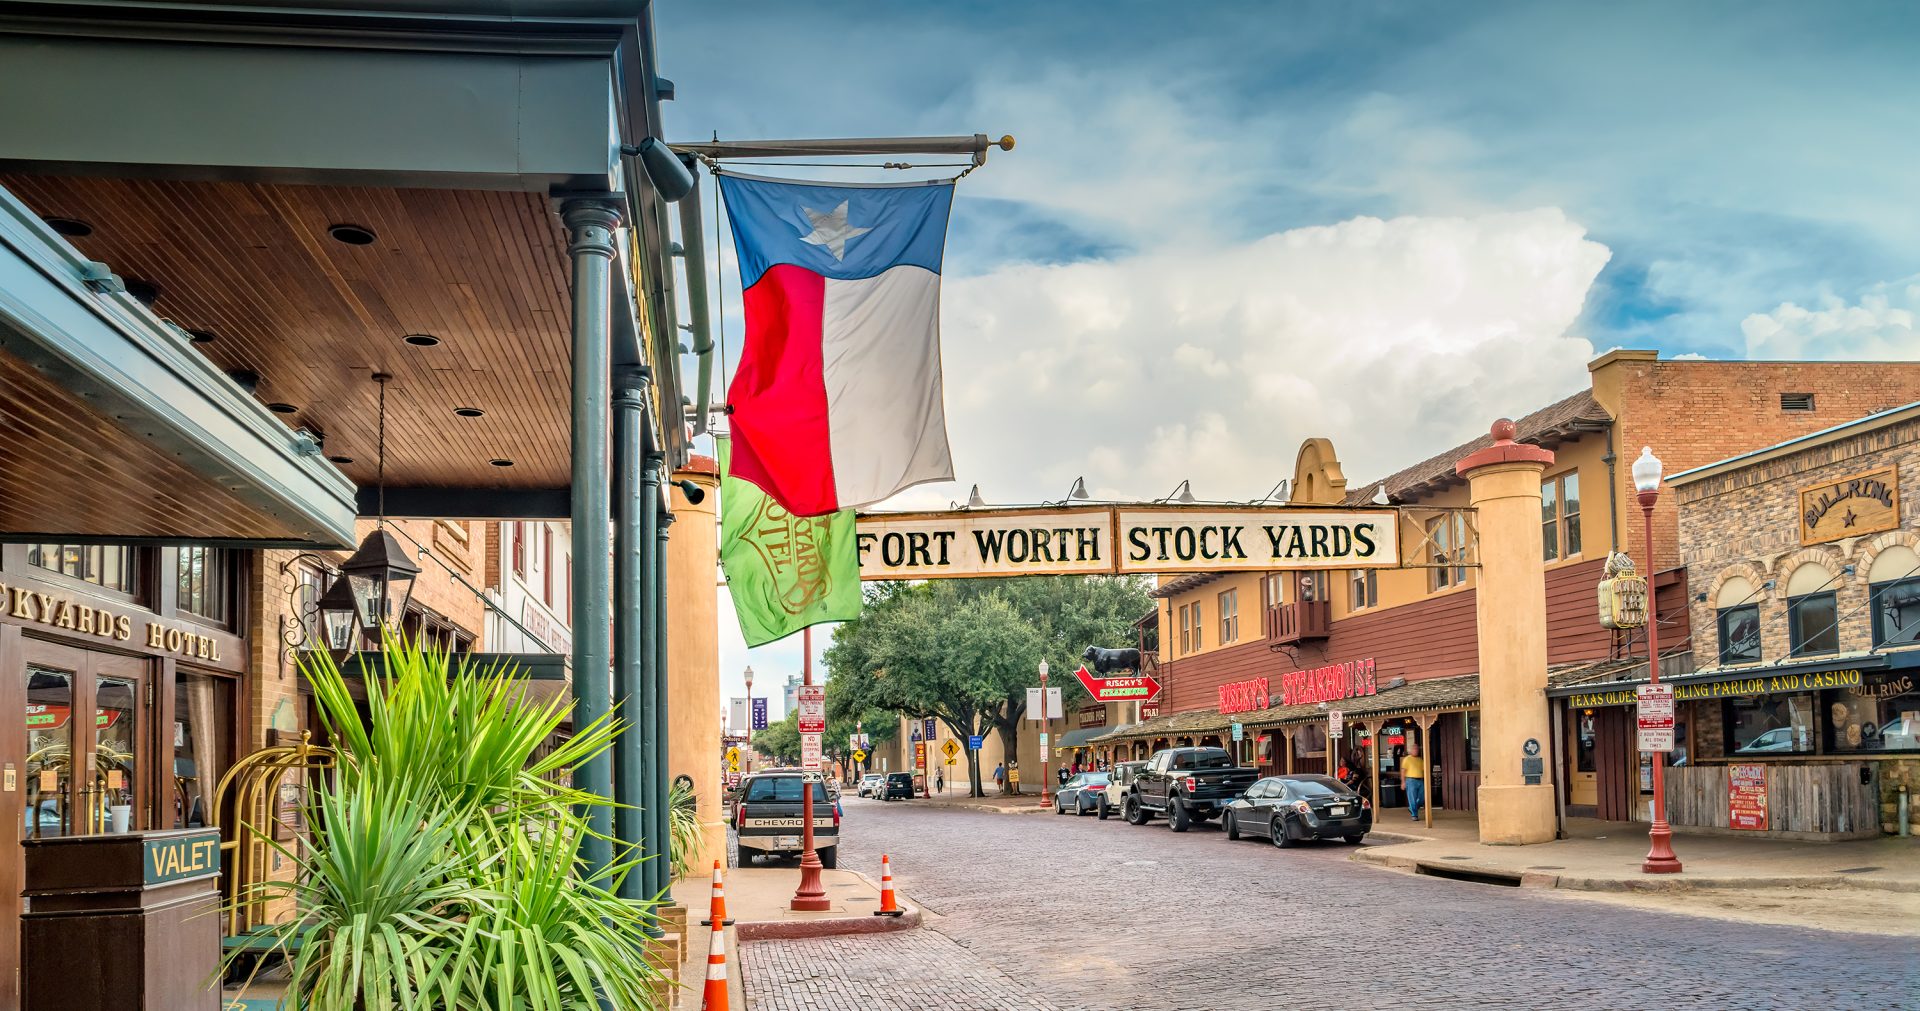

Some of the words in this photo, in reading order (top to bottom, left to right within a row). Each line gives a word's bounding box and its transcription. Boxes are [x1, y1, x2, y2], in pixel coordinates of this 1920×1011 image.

[758, 499, 792, 575] OTEL
[856, 531, 956, 568] FORT
[972, 527, 1101, 565] WORTH
[1128, 525, 1248, 562] STOCK
[1262, 523, 1376, 558] YARDS
[147, 622, 221, 662] HOTEL
[1218, 676, 1270, 715] RISCKY'S
[1282, 657, 1377, 706] STEAKHOUSE
[1570, 692, 1603, 707] TEXAS
[1606, 690, 1637, 705] OLDES
[1675, 683, 1708, 699] BLING
[1713, 678, 1765, 696] PARLOR
[1770, 674, 1799, 691] AND
[1803, 669, 1860, 688] CASINO
[1880, 676, 1914, 698] RING
[151, 840, 215, 877] VALET
